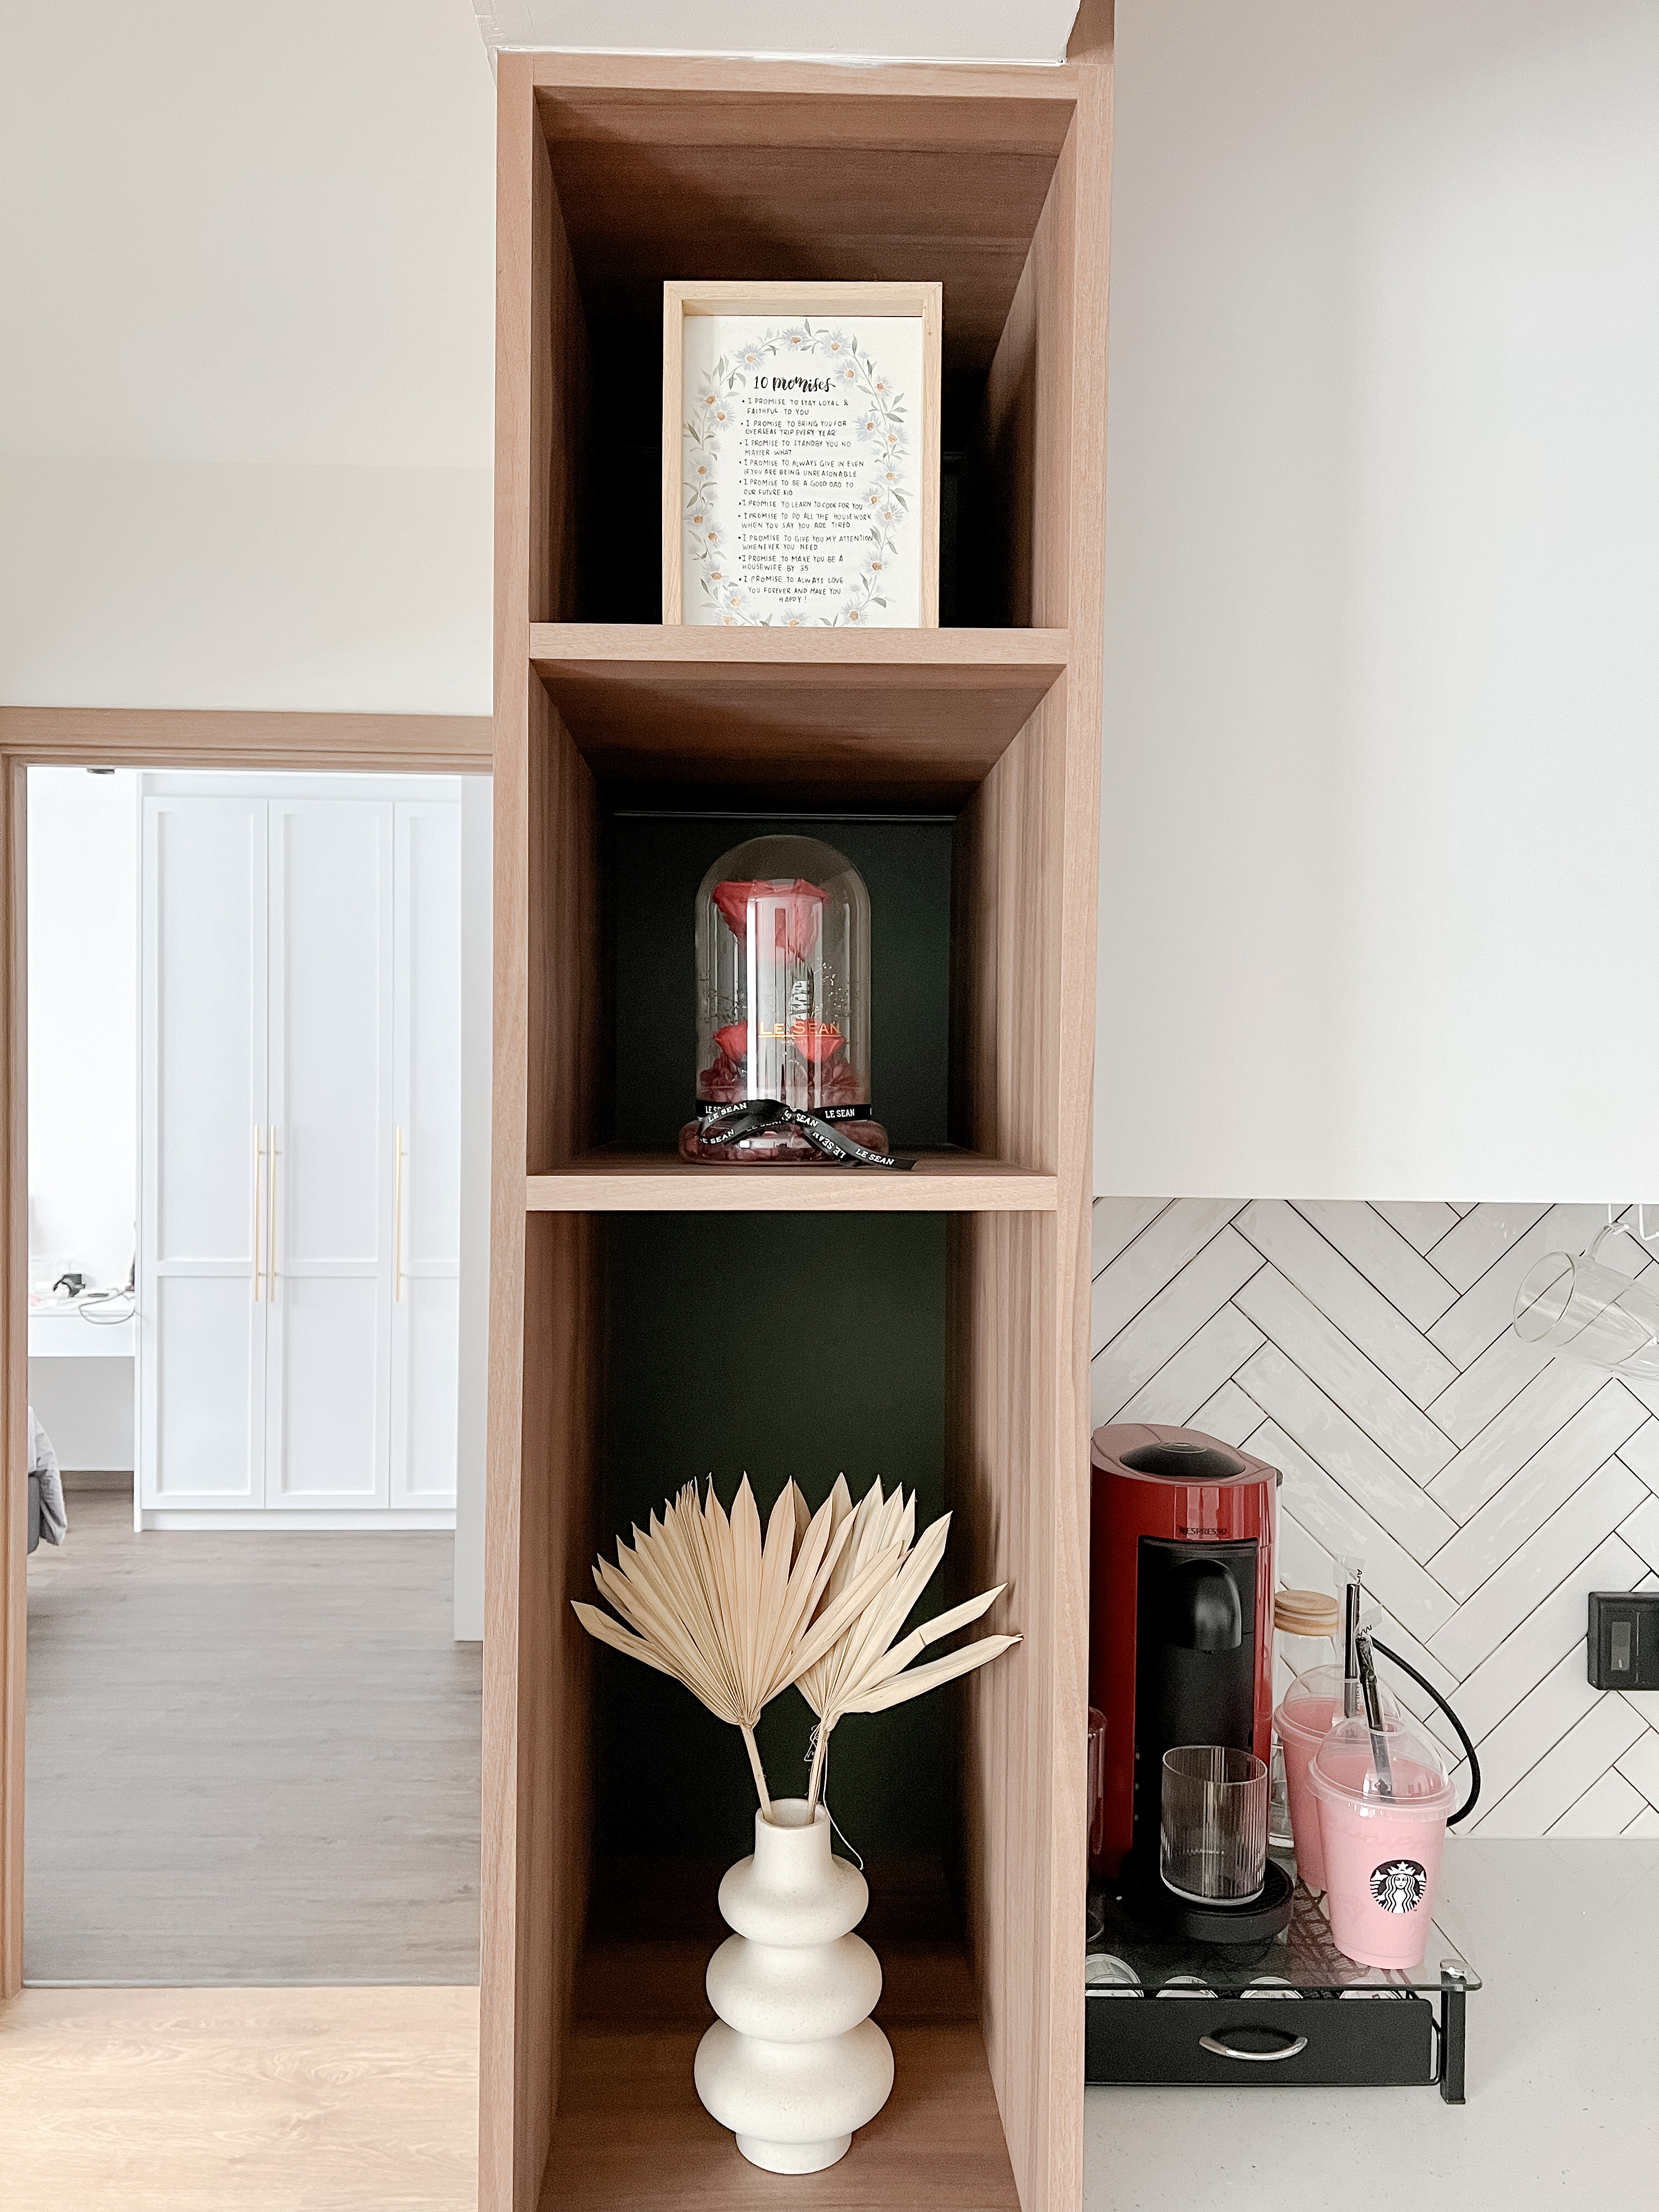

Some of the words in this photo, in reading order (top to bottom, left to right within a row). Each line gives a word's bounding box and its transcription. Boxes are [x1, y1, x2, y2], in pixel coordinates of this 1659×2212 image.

[754, 376, 768, 388] 10
[760, 1022, 785, 1035] LE
[791, 1020, 842, 1035] SEAN
[708, 1112, 719, 1123] LE
[720, 1102, 747, 1115] SEAN
[796, 1113, 819, 1127] SEAN
[825, 1110, 835, 1119] LE
[837, 1109, 855, 1118] SEAN
[710, 1128, 735, 1144] SEAN
[812, 1131, 834, 1150] SEAN
[833, 1147, 847, 1159] LE
[855, 1148, 867, 1159] LE
[868, 1154, 895, 1165] SEAN
